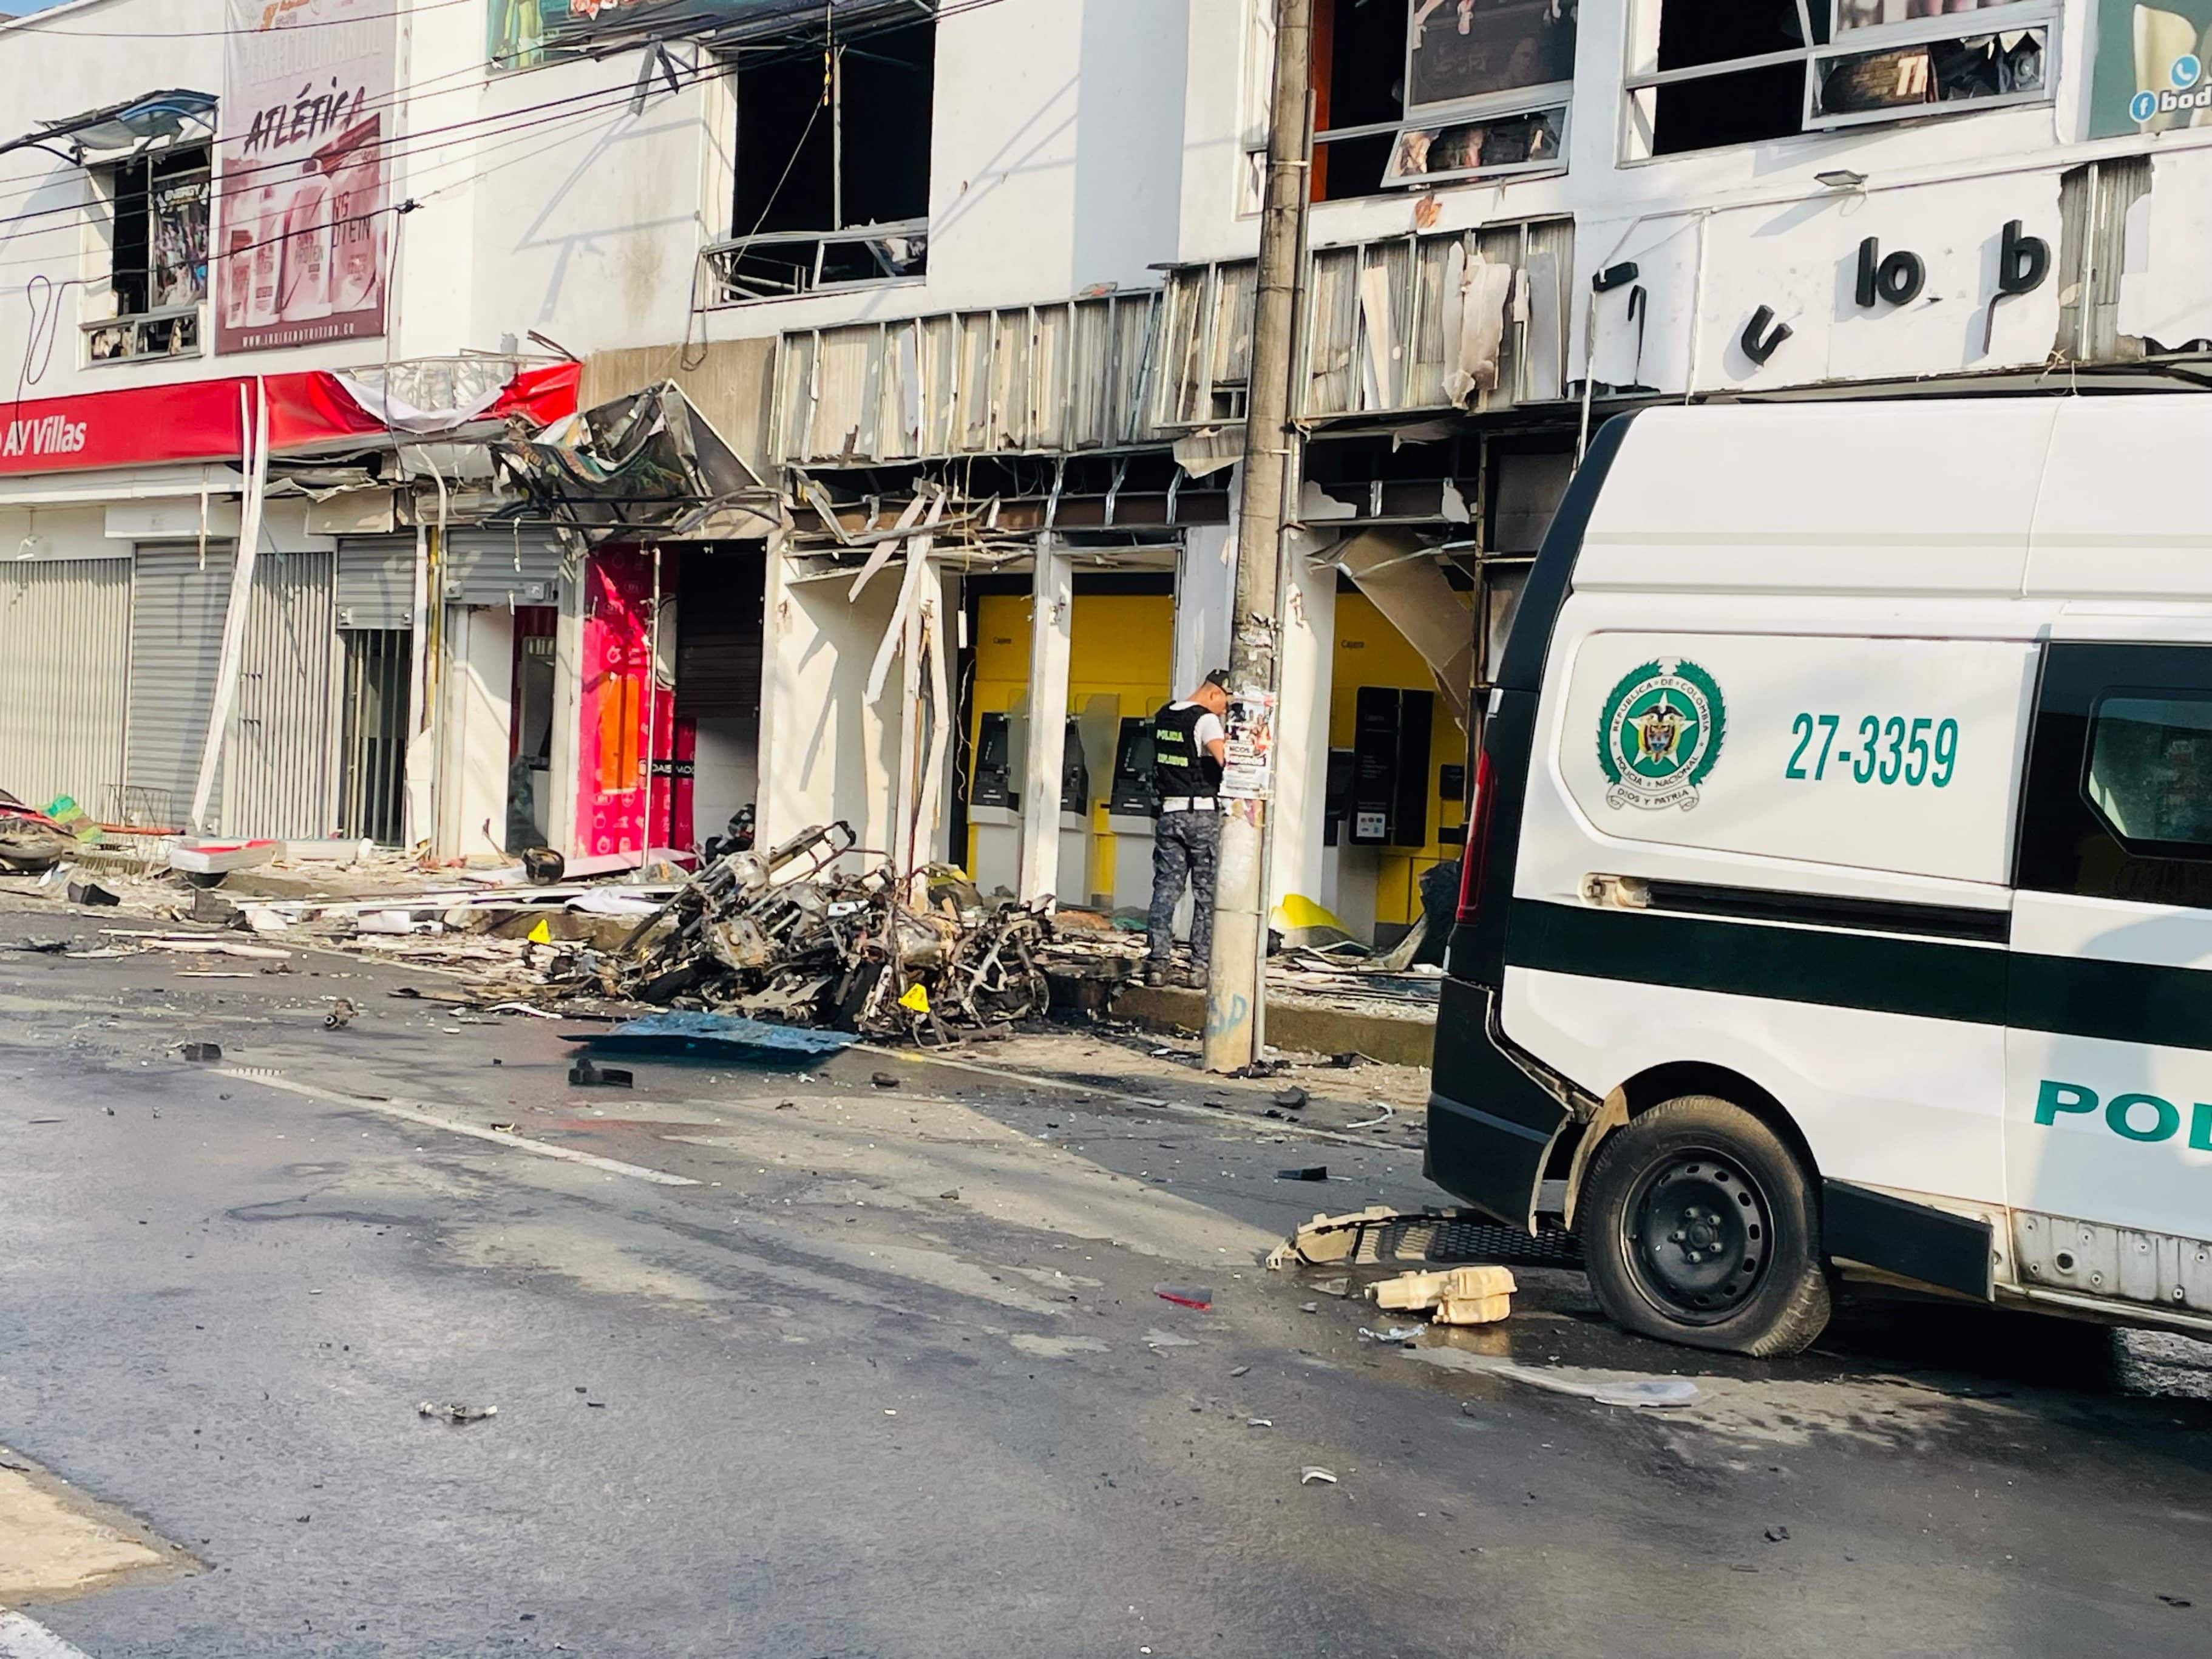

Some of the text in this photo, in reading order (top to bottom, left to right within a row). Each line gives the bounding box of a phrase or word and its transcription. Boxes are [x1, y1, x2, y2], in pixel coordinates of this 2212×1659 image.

[33, 415, 87, 455] Villas
[1680, 683, 1710, 733] COLOMBIA
[1786, 713, 1958, 788] 27-3359
[1616, 755, 1700, 788] POLICIA NACIONAL
[1617, 788, 1640, 802] DIOS
[1654, 790, 1689, 805] PATRIA
